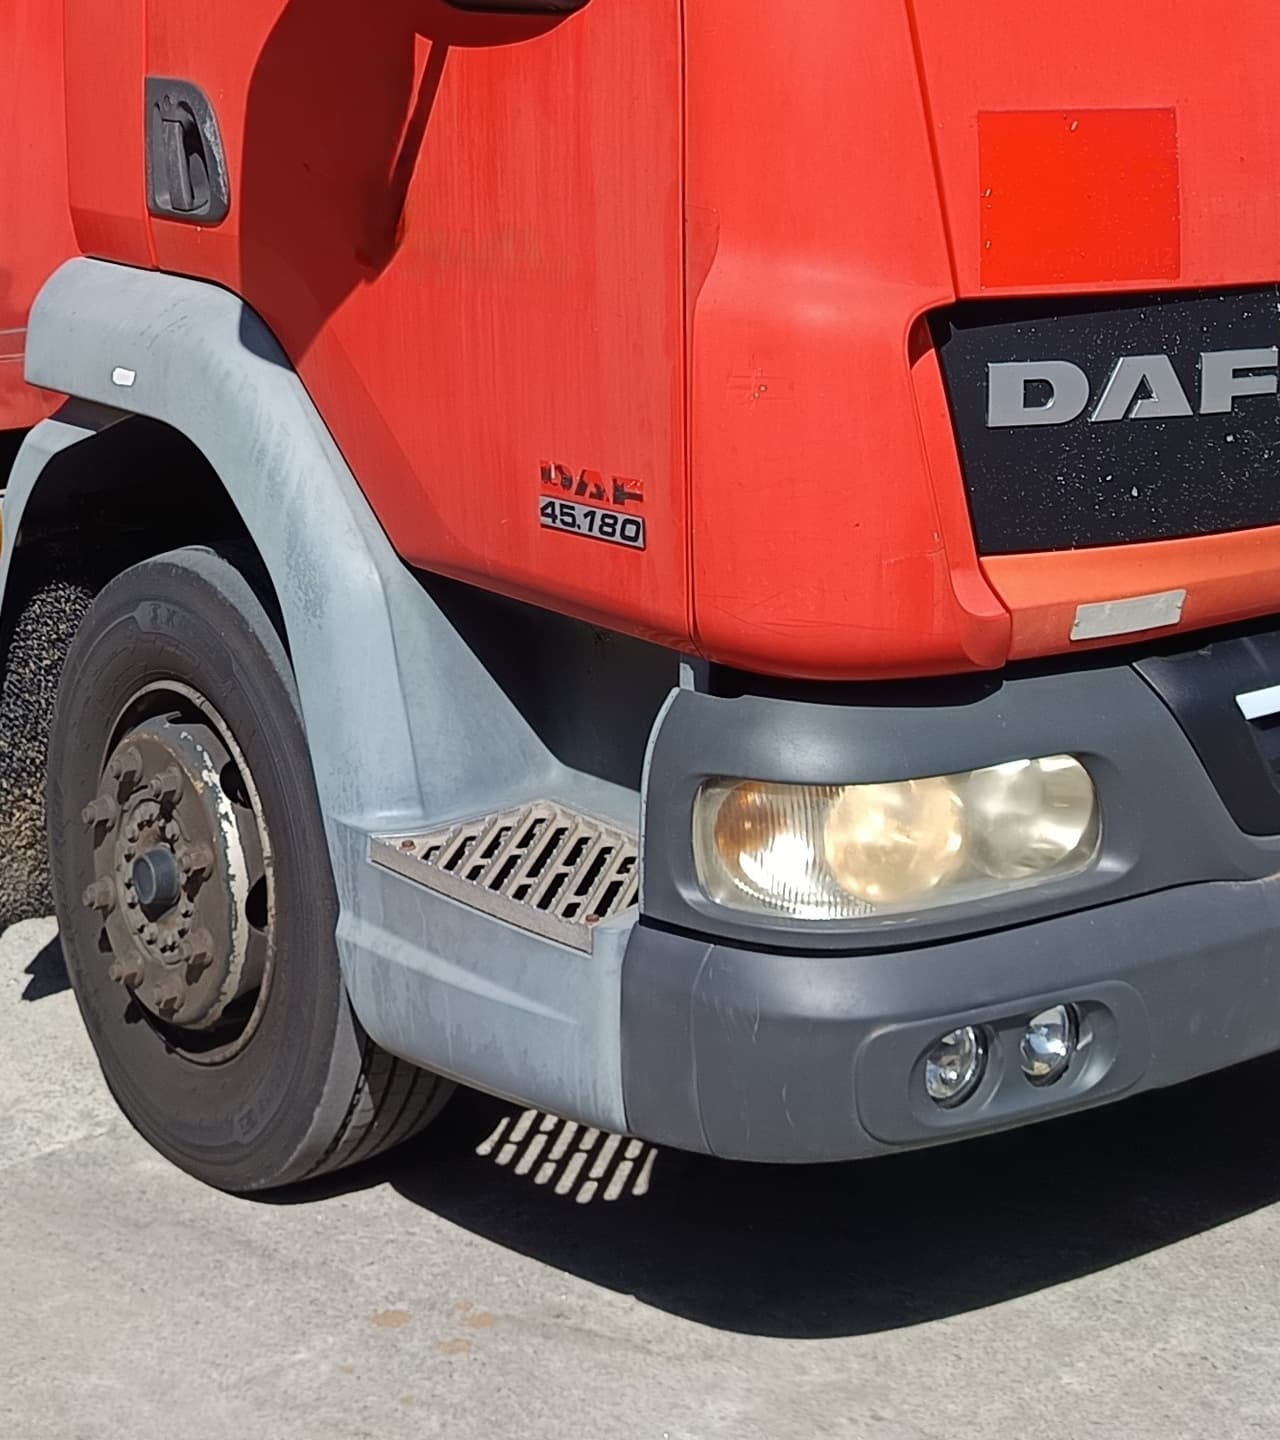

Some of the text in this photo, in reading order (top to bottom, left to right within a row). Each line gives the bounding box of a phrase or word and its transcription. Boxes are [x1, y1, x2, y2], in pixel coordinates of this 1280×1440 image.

[985, 346, 1280, 429] DAF
[540, 459, 644, 506] DAF
[539, 500, 642, 544] 45.180
